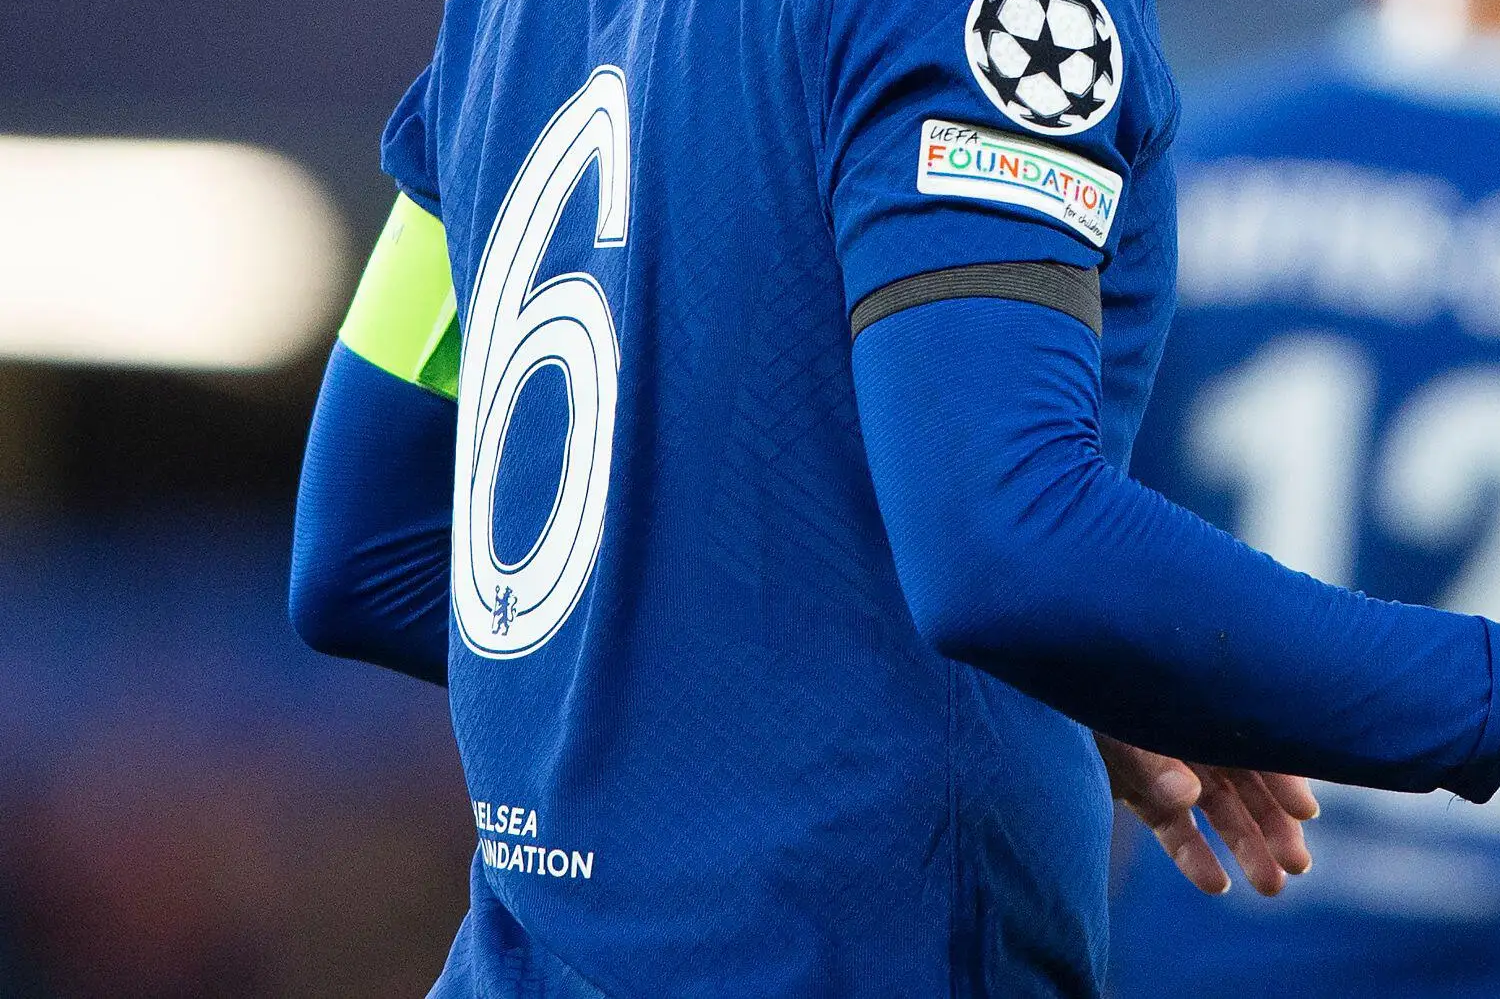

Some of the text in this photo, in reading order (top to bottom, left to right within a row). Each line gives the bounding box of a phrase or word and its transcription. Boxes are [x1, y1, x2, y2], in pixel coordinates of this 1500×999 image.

[930, 125, 980, 144] UEFA
[1063, 203, 1077, 218] for
[452, 64, 630, 660] 6
